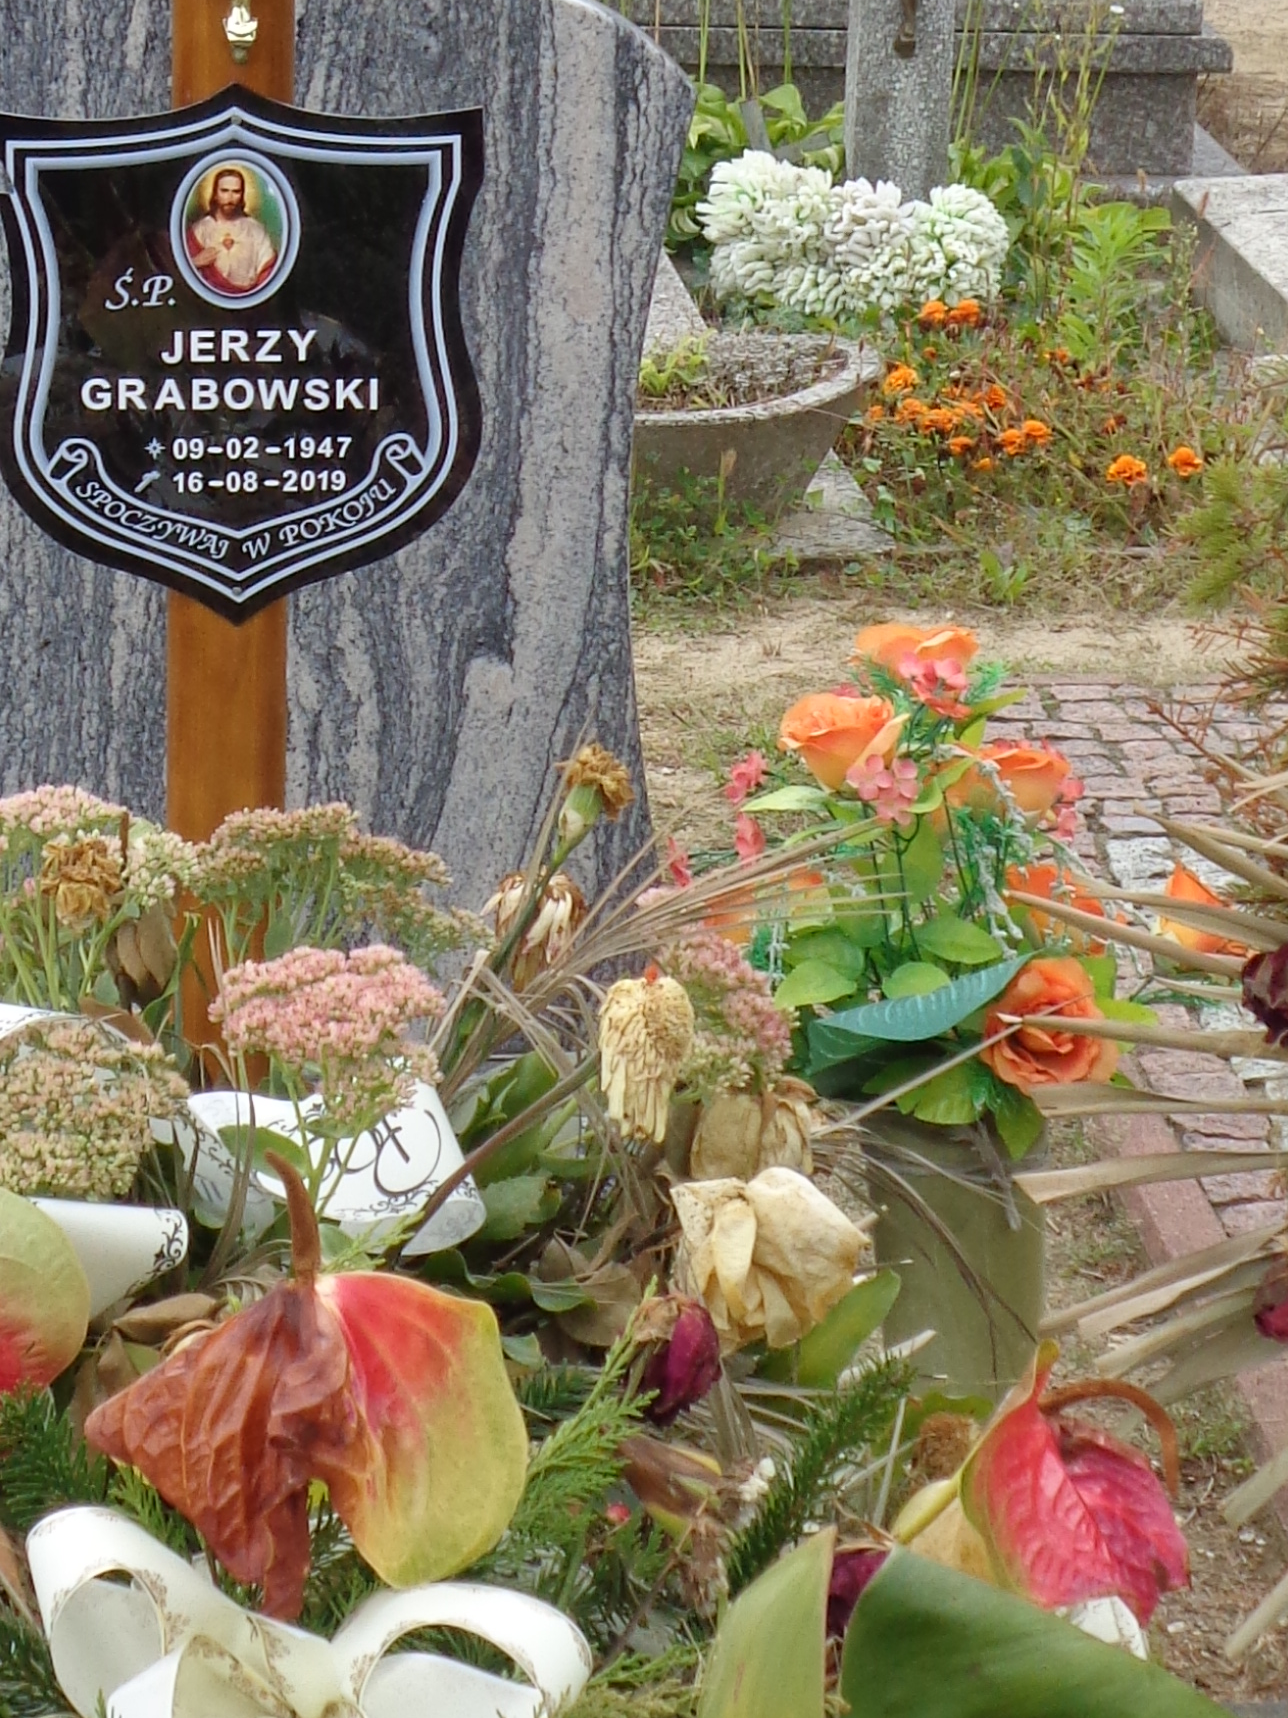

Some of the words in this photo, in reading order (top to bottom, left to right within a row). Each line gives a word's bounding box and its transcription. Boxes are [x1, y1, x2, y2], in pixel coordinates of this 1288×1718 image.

[104, 267, 177, 311] Ś.P.
[161, 329, 318, 365] JERZY
[80, 377, 380, 412] GRABOWSKI
[171, 469, 347, 494] 16-08-2019
[75, 480, 231, 560] SPOCZYWAJ
[241, 533, 273, 560] W
[278, 477, 398, 548] POKOJU
